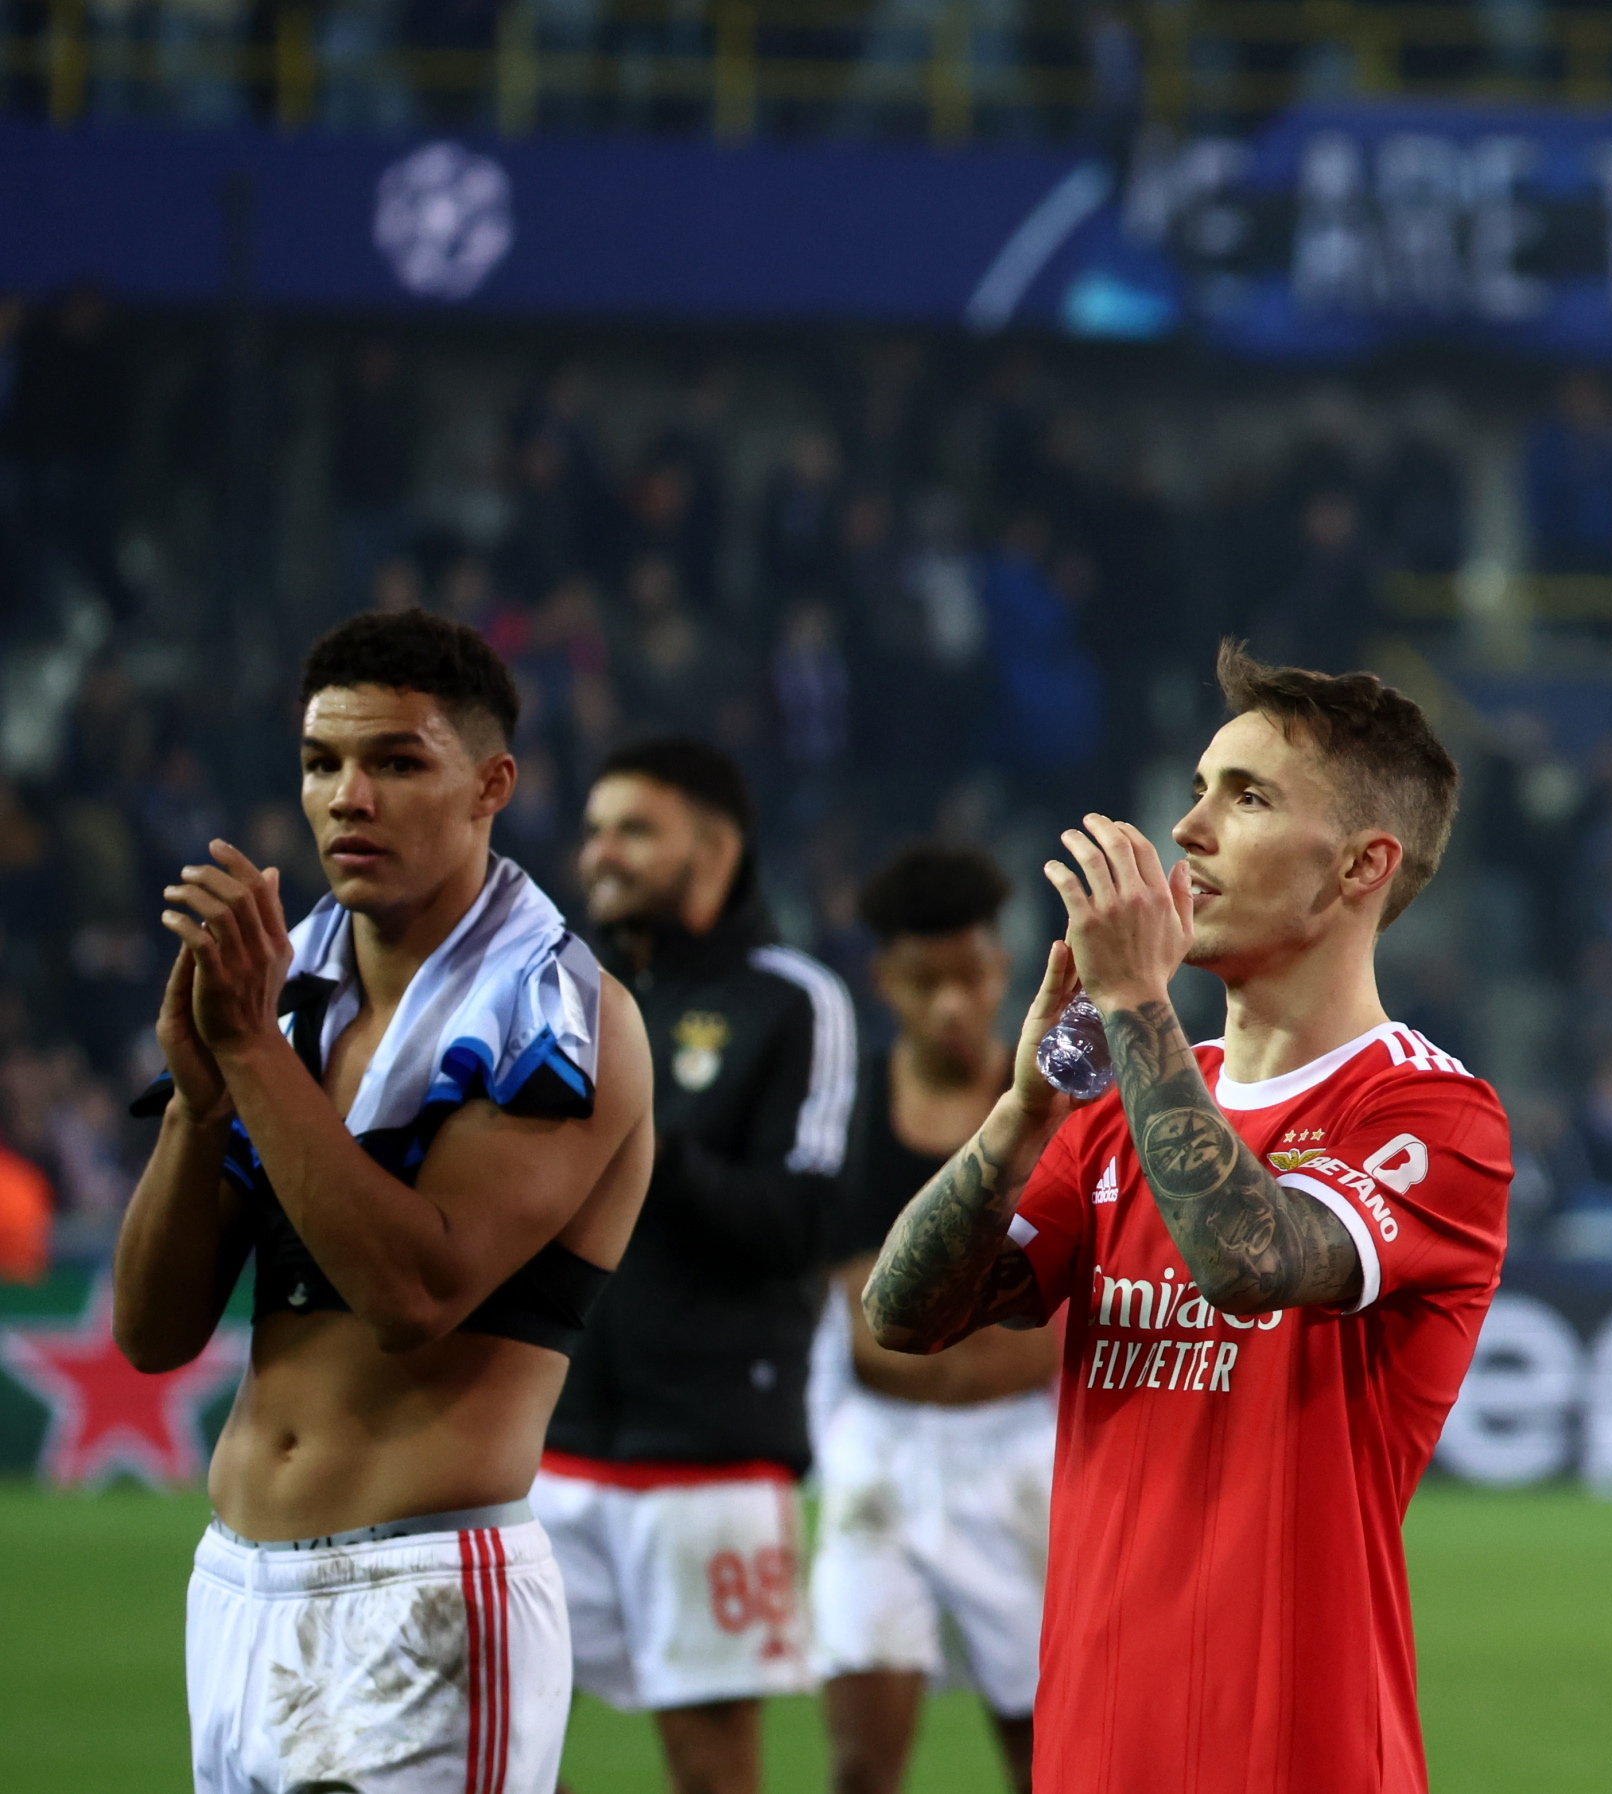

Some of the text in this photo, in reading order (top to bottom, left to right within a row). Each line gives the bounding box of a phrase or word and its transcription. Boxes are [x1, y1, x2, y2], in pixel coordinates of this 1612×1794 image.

[1091, 1187, 1119, 1205] adidas
[1299, 1156, 1399, 1243] BETANO
[1087, 1340, 1143, 1390] FLY
